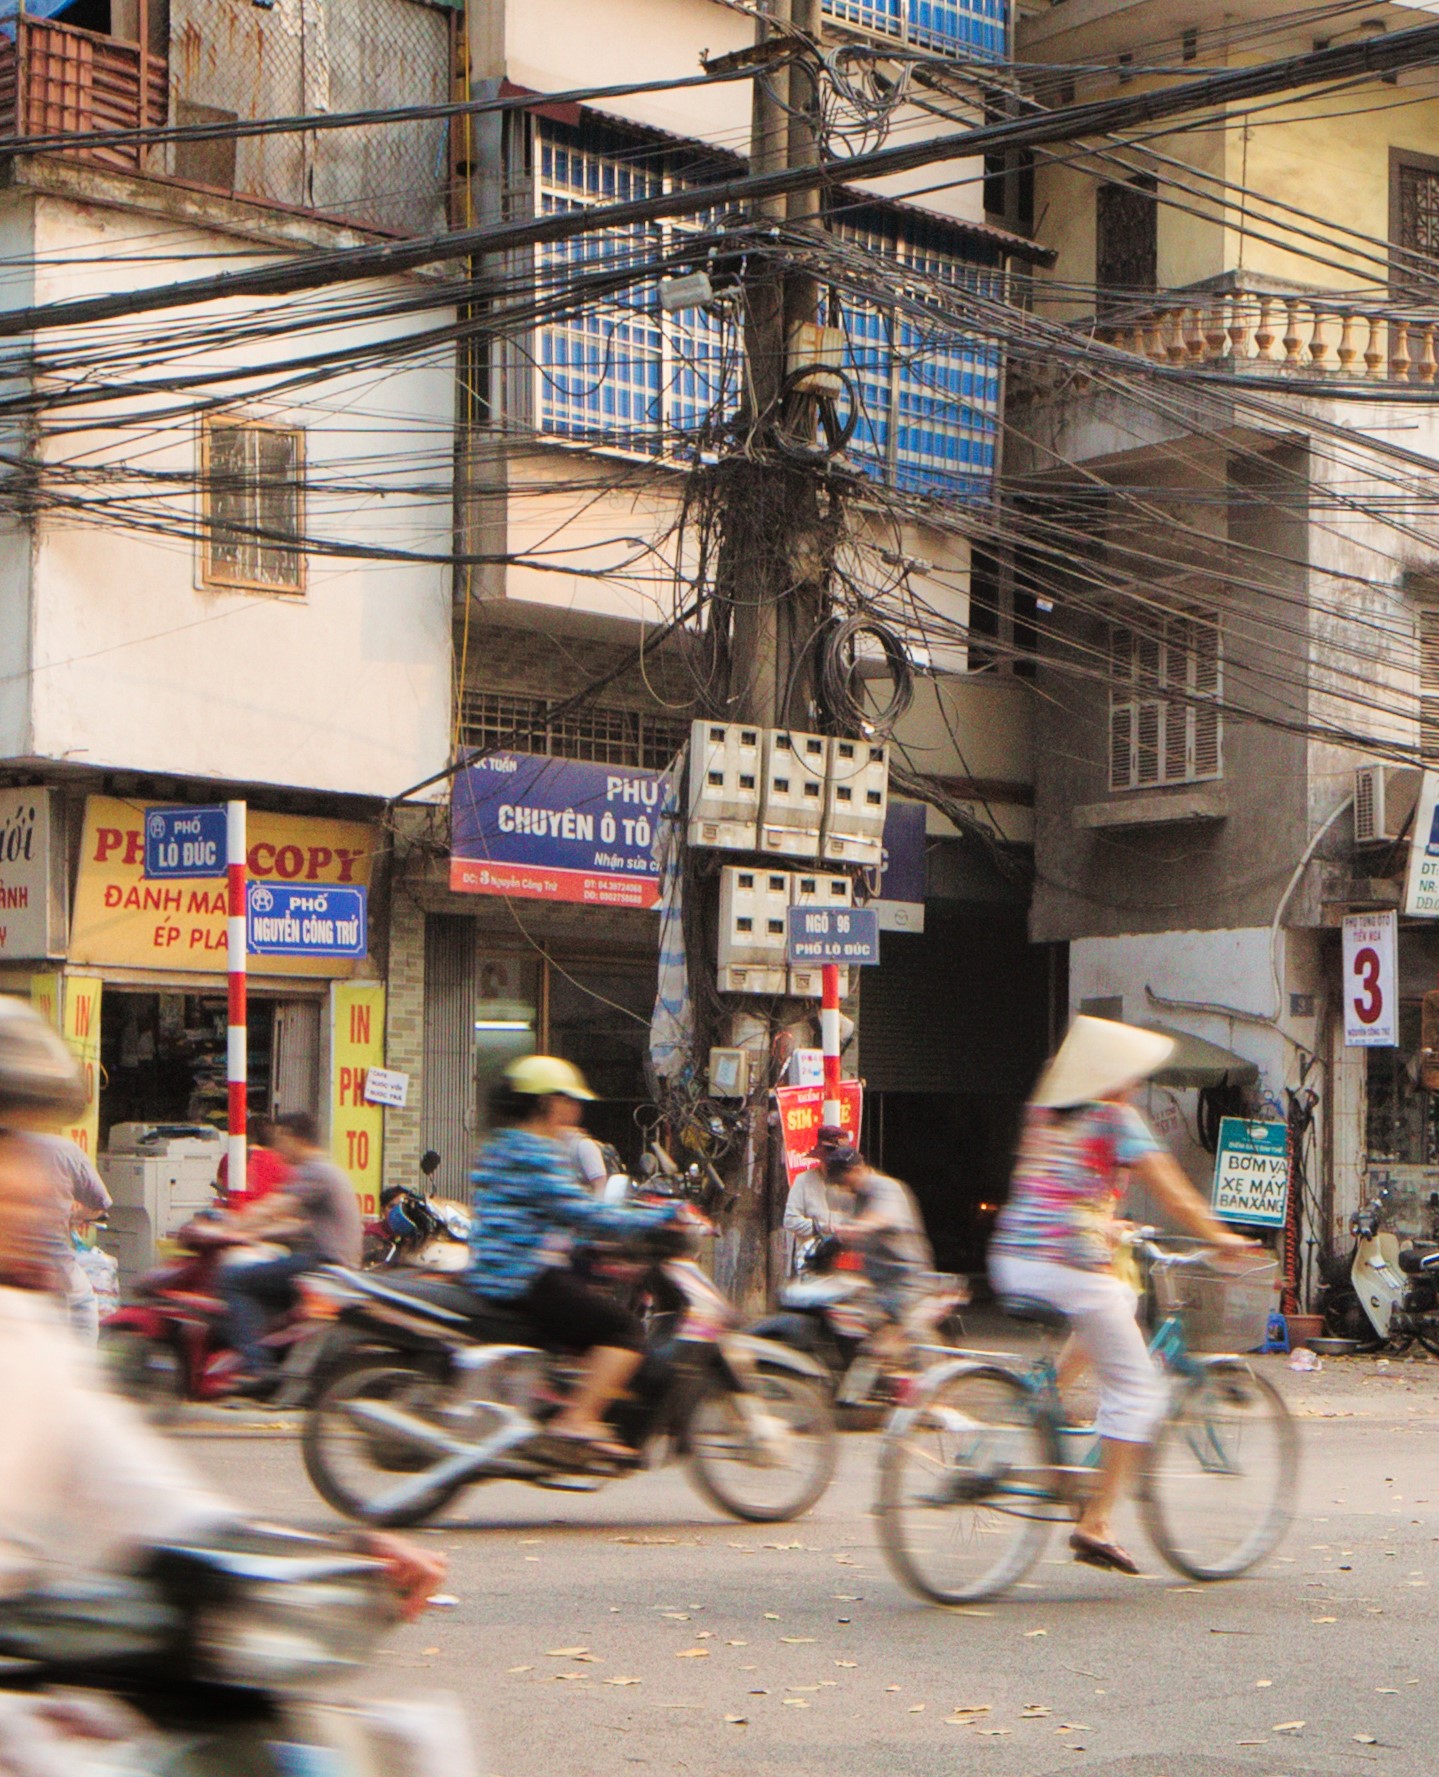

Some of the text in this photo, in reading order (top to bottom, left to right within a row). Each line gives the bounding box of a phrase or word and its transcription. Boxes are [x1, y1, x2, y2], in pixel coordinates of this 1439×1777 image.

[607, 775, 658, 813] PHỤ
[174, 814, 201, 834] PHỐ
[498, 804, 651, 847] CHUYÊN Ô TÔ
[159, 837, 216, 867] LÒ ĐÚC
[594, 852, 647, 872] Nhận sửa
[104, 874, 229, 915] ĐÁNH MÁ
[480, 870, 489, 885] 3
[521, 876, 543, 892] Công
[289, 893, 328, 912] PHỐ
[154, 916, 181, 947] ÉP
[253, 910, 359, 945] NGUYỄN CÔNG TRỨ
[805, 911, 850, 933] NGÕ 96
[795, 938, 870, 955] PHỐ LÒ ĐÚC
[1353, 947, 1383, 1025] 3
[76, 995, 90, 1037] IN
[350, 1004, 370, 1044] IN
[787, 1108, 812, 1130] SIM
[346, 1131, 369, 1170] TO
[1229, 1155, 1266, 1173] BƠM
[1250, 1175, 1285, 1196] MÁY
